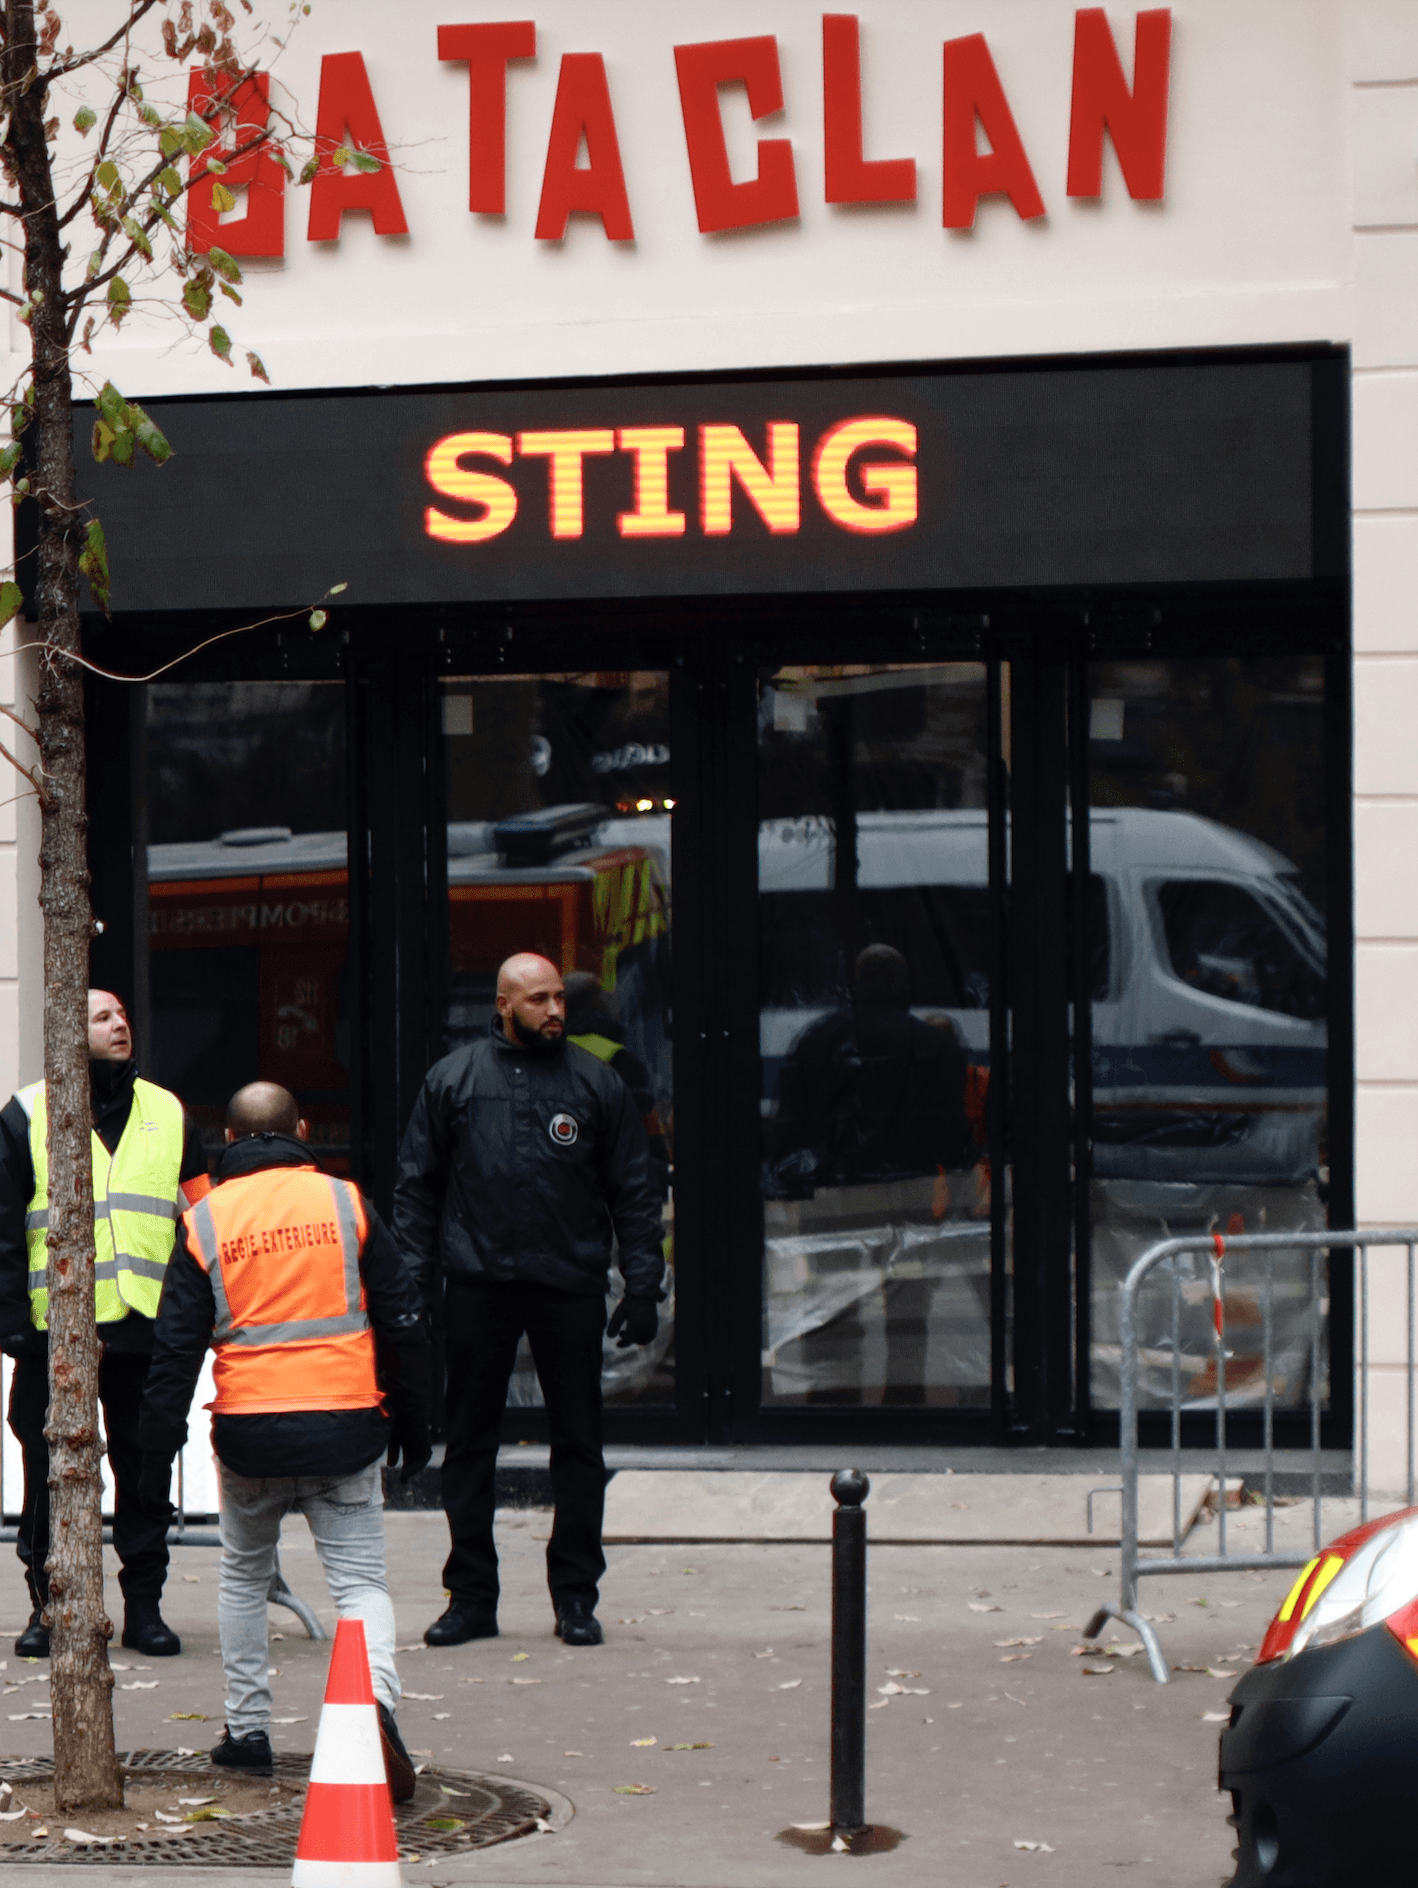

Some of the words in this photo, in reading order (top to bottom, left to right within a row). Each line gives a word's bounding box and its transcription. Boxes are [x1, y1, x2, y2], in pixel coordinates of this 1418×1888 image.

[185, 7, 1173, 257] BATACLAN
[423, 415, 919, 543] STING
[261, 1221, 338, 1254] EXTERIEURE
